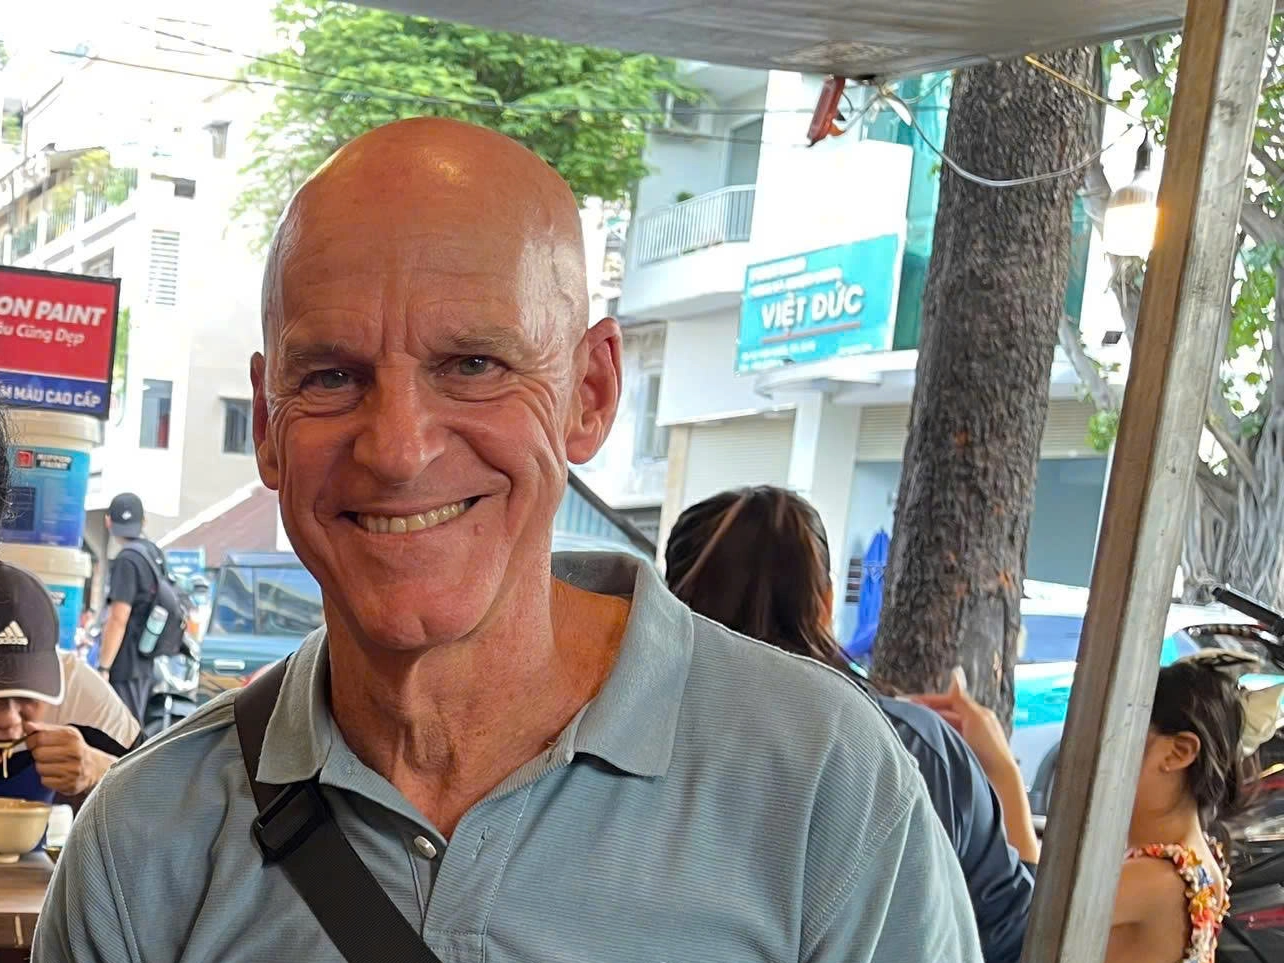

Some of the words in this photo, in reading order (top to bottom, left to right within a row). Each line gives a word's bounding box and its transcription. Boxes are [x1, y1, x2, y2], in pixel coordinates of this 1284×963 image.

[35, 300, 107, 327] PAINT
[16, 323, 53, 343] Cũng
[45, 389, 72, 406] CAO
[73, 390, 101, 408] CẤP
